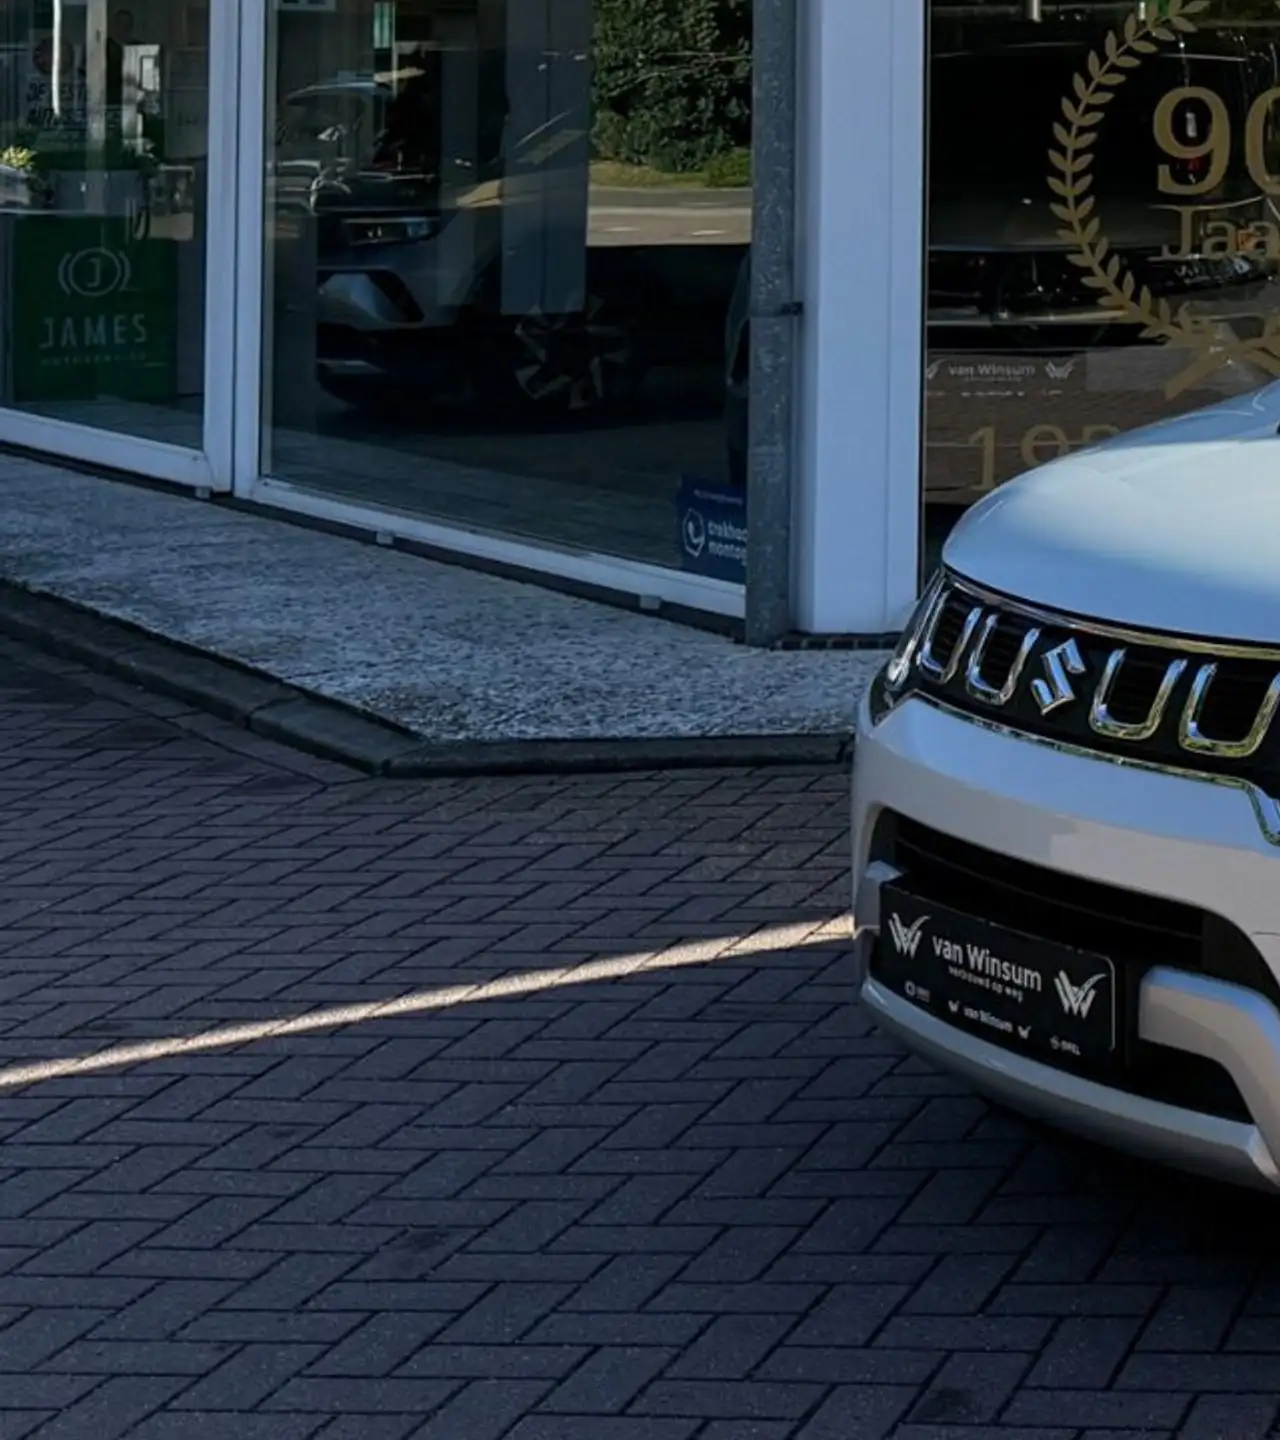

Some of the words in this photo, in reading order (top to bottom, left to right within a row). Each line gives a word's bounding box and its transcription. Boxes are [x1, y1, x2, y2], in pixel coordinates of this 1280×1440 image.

[39, 313, 147, 349] JAMES
[931, 934, 964, 965] van
[966, 943, 1042, 993] Winsum
